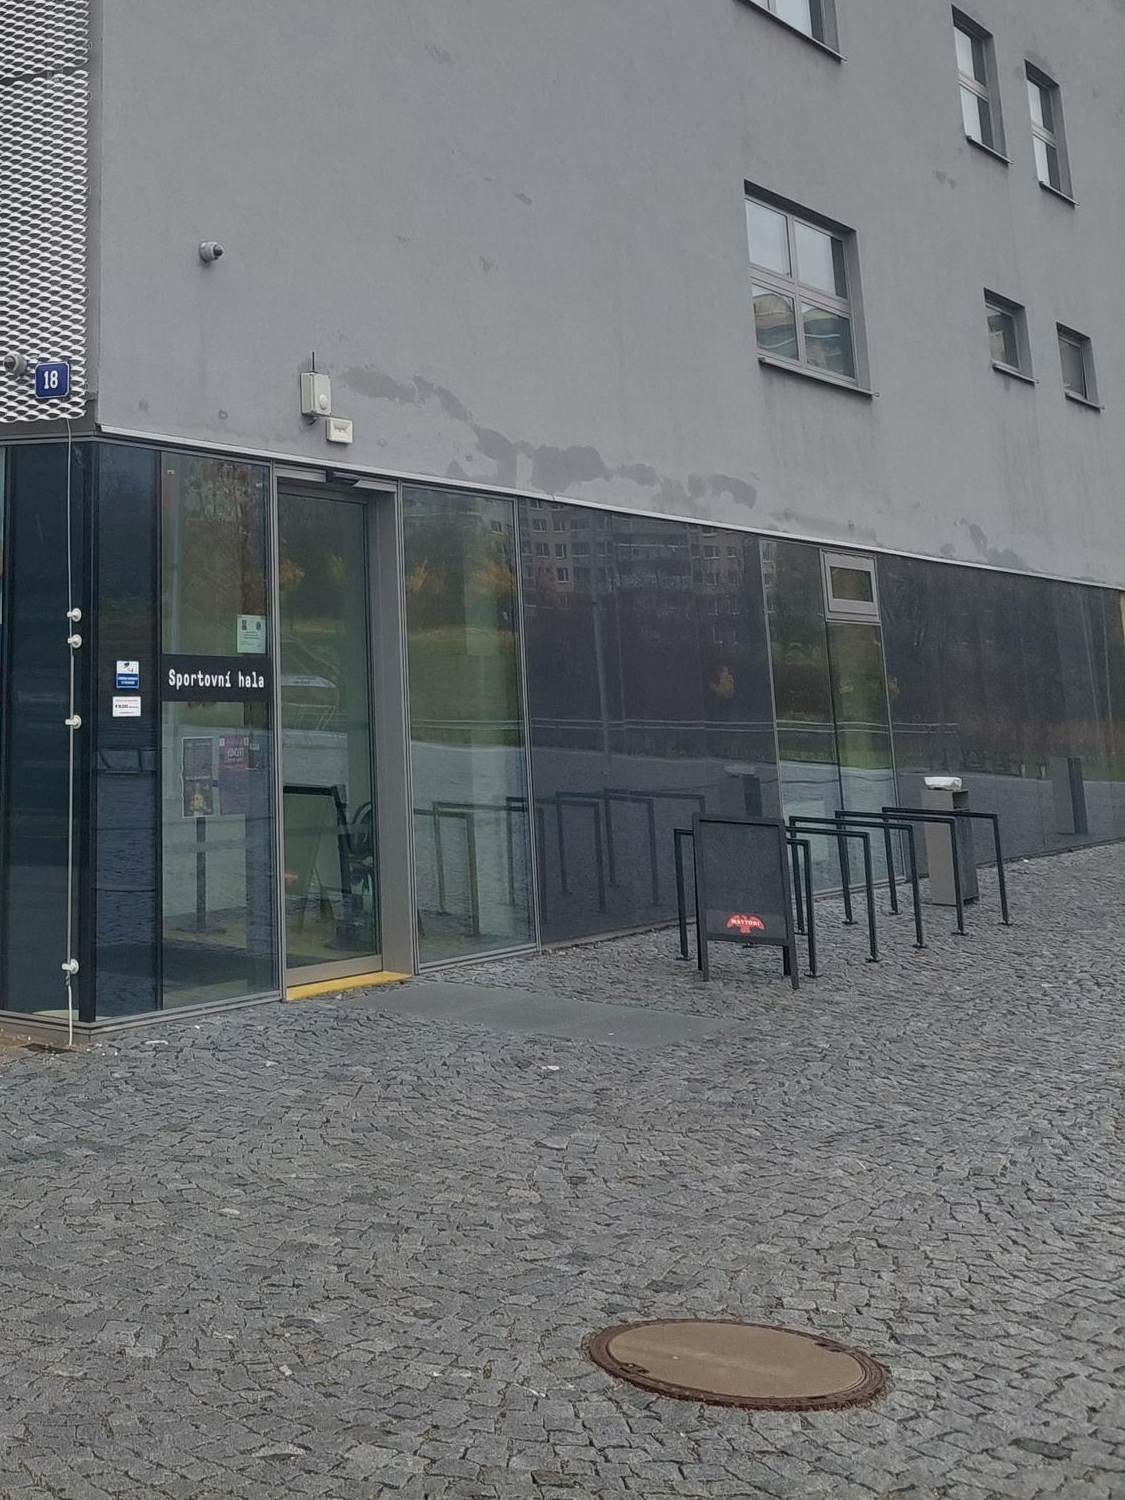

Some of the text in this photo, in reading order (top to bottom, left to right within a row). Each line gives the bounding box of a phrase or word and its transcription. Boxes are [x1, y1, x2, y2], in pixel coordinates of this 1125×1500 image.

[43, 370, 59, 390] 18
[168, 668, 265, 690] Sportovní hala
